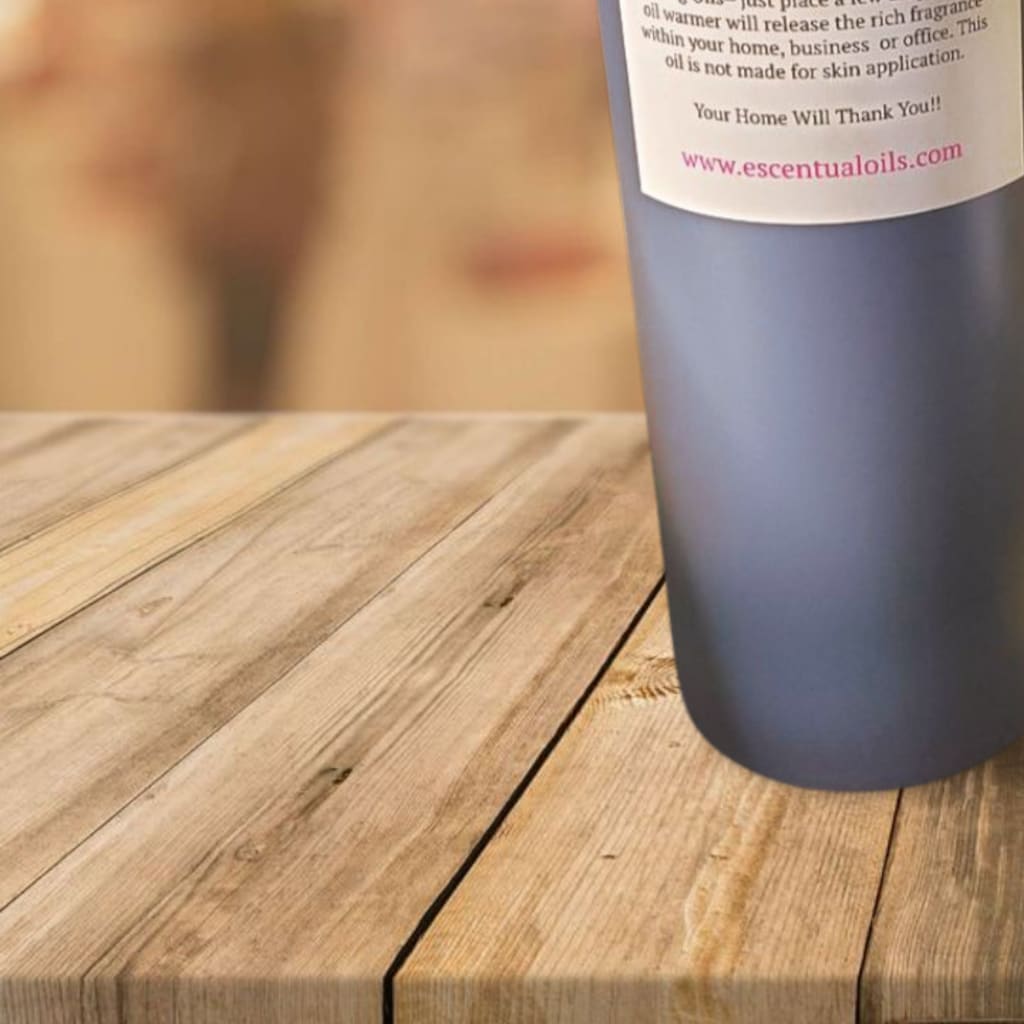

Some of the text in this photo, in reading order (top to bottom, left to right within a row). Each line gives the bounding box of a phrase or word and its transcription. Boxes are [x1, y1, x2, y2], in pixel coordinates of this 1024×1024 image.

[643, 3, 661, 21] oil
[663, 7, 721, 29] warmer
[726, 13, 760, 32] will
[763, 14, 830, 32] release
[834, 13, 865, 30] the
[870, 8, 906, 28] rich
[641, 15, 988, 58] within your home, business or office. This
[665, 47, 965, 79] oil is not made for skin application.
[694, 96, 942, 126] Your Home Will Thank You!!
[680, 140, 964, 180] www.escentualoils.com
